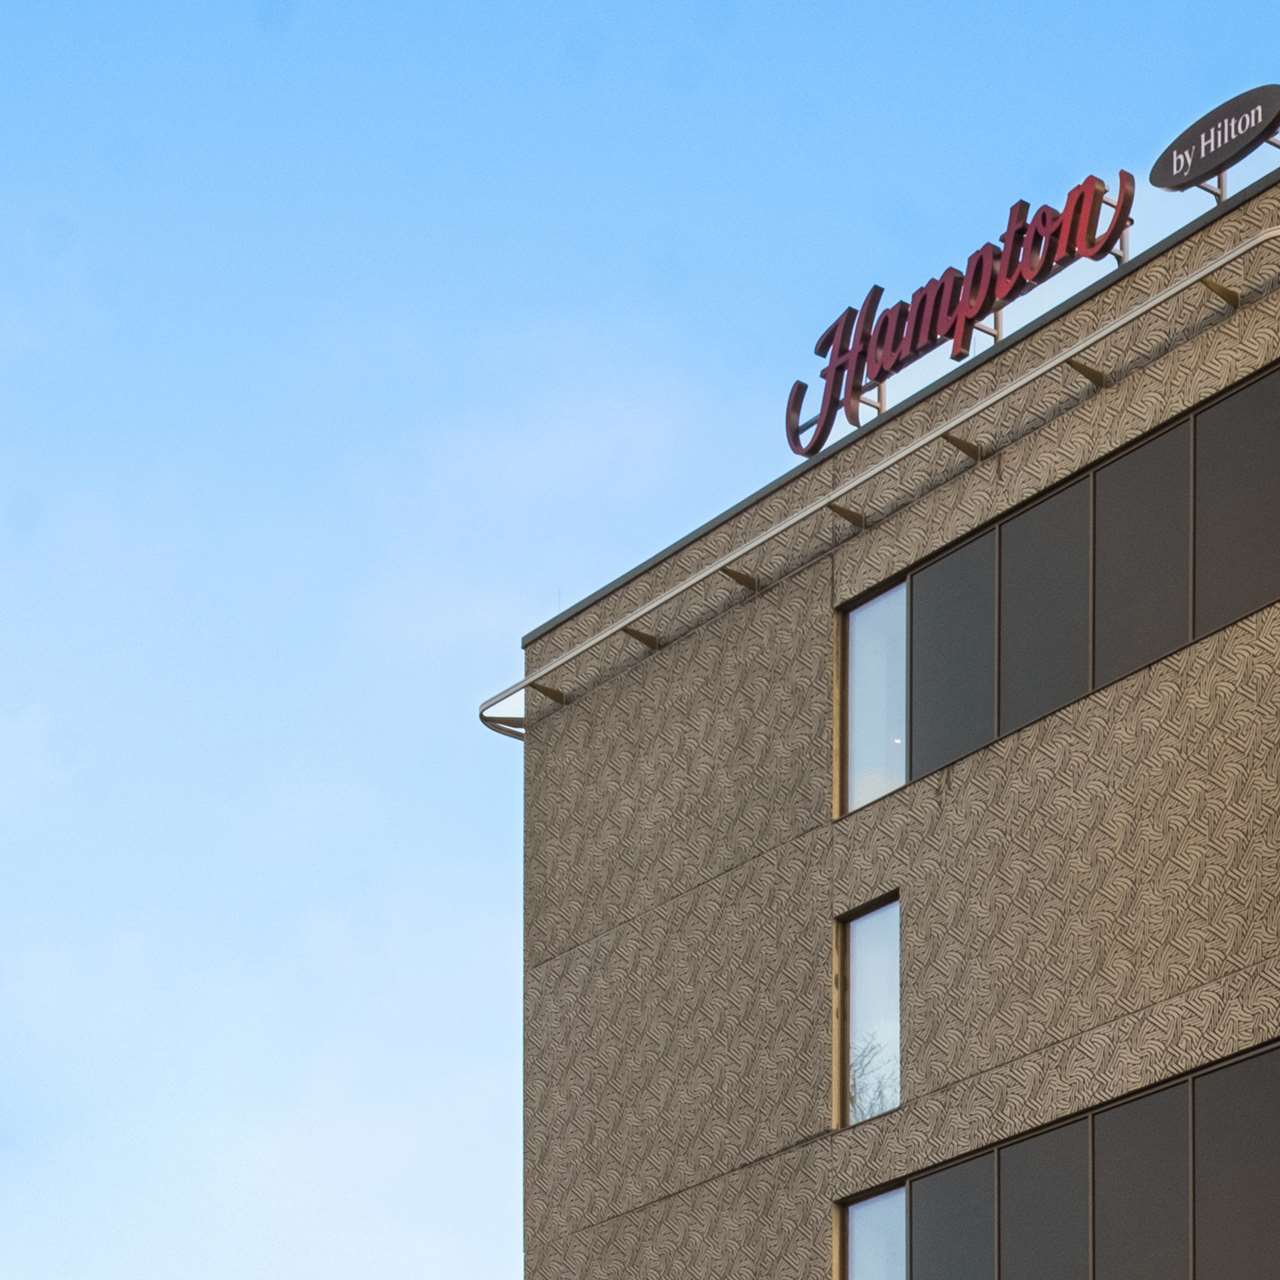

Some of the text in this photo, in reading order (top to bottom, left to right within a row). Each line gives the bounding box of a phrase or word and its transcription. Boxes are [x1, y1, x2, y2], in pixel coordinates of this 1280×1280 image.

[1172, 104, 1264, 176] by Hilton
[786, 169, 1135, 458] Hampton
